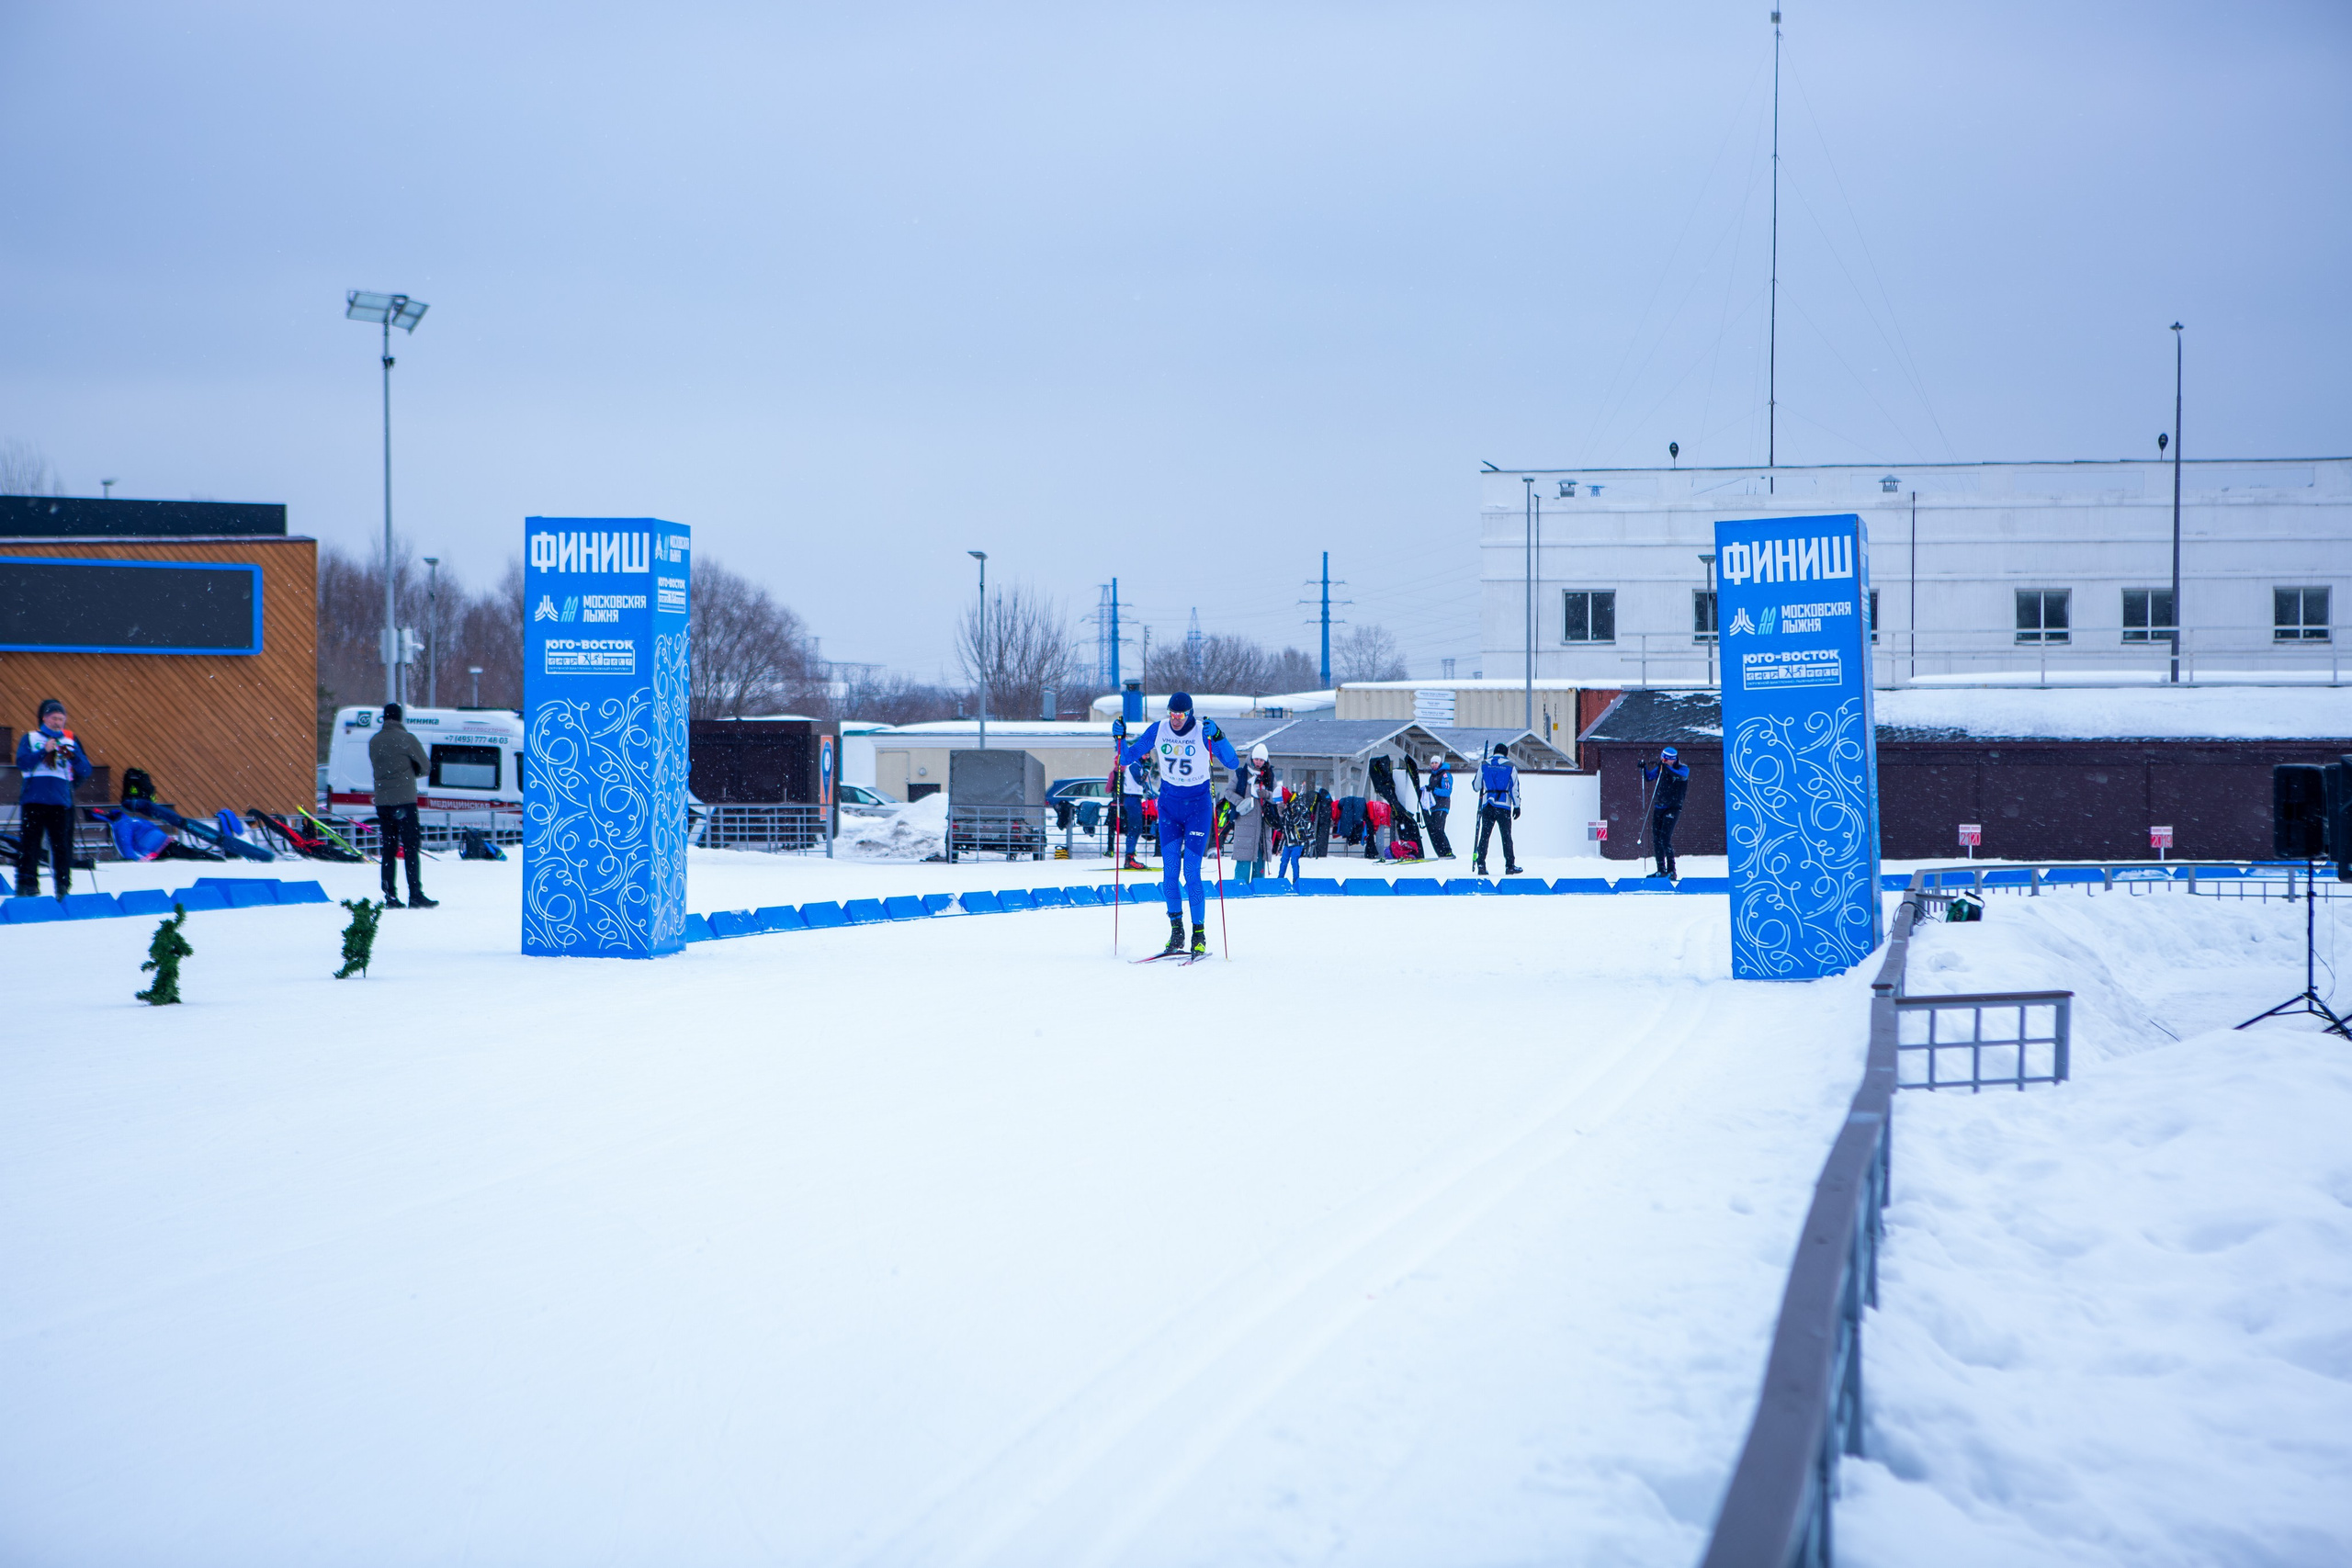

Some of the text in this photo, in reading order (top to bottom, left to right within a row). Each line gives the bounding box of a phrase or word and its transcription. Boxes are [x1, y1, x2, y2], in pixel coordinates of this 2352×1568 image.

[531, 531, 650, 573] ФИНИШ
[1722, 535, 1853, 585] ФИНИШ
[582, 595, 647, 609] МОСКОВСКАЯ
[582, 609, 619, 623] ЛЫЖНЯ
[1781, 601, 1852, 619] МОСКОВСКАЯ
[1781, 617, 1822, 634] ЛЫЖНЯ
[545, 638, 635, 650] ЮГО-ВОСТОК
[1742, 649, 1840, 664] ЮГО-ВОСТОК
[474, 736, 487, 744] 777
[1164, 757, 1193, 776] 75
[429, 799, 491, 810] МЕДИЦИНСКАЯ
[1597, 828, 1607, 840] 22
[1960, 832, 1981, 846] 21 20
[2151, 835, 2162, 848] 20
